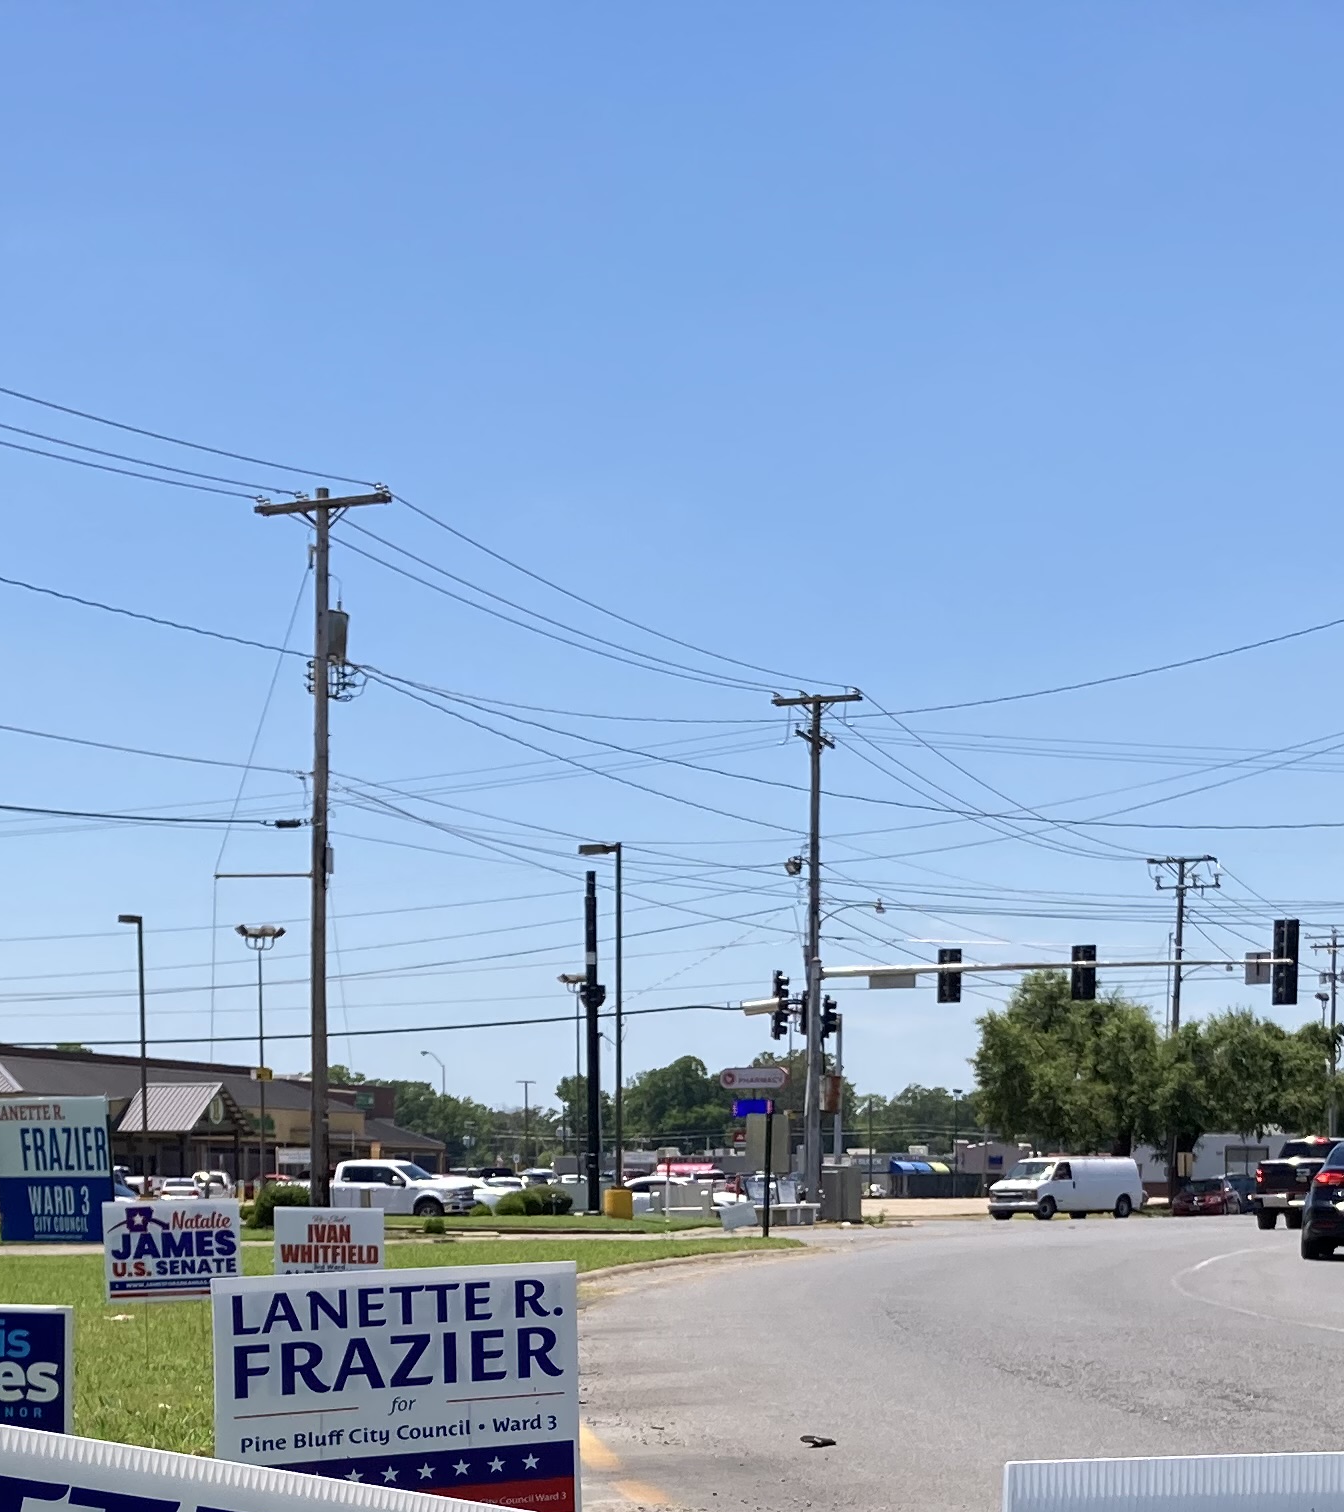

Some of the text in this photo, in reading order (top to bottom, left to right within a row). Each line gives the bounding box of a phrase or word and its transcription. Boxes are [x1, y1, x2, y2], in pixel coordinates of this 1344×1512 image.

[53, 1104, 66, 1120] R.
[20, 1126, 108, 1172] FRAZIER
[28, 1185, 91, 1215] WARD 3
[34, 1216, 89, 1233] CITY COUNCIL
[171, 1210, 233, 1230] Natalie
[307, 1224, 351, 1243] IVAN
[111, 1230, 237, 1260] JAMES
[280, 1244, 379, 1264] WHITFIELD
[112, 1258, 236, 1277] U.S. SENATE
[231, 1279, 564, 1336] LANETTE R.
[233, 1326, 565, 1400] FRAZIER
[387, 1396, 417, 1416] for
[240, 1413, 557, 1454] Pine Bluff City Council Ward 3
[499, 1494, 535, 1505] Council
[535, 1493, 559, 1502] Ward
[561, 1492, 567, 1500] 3
